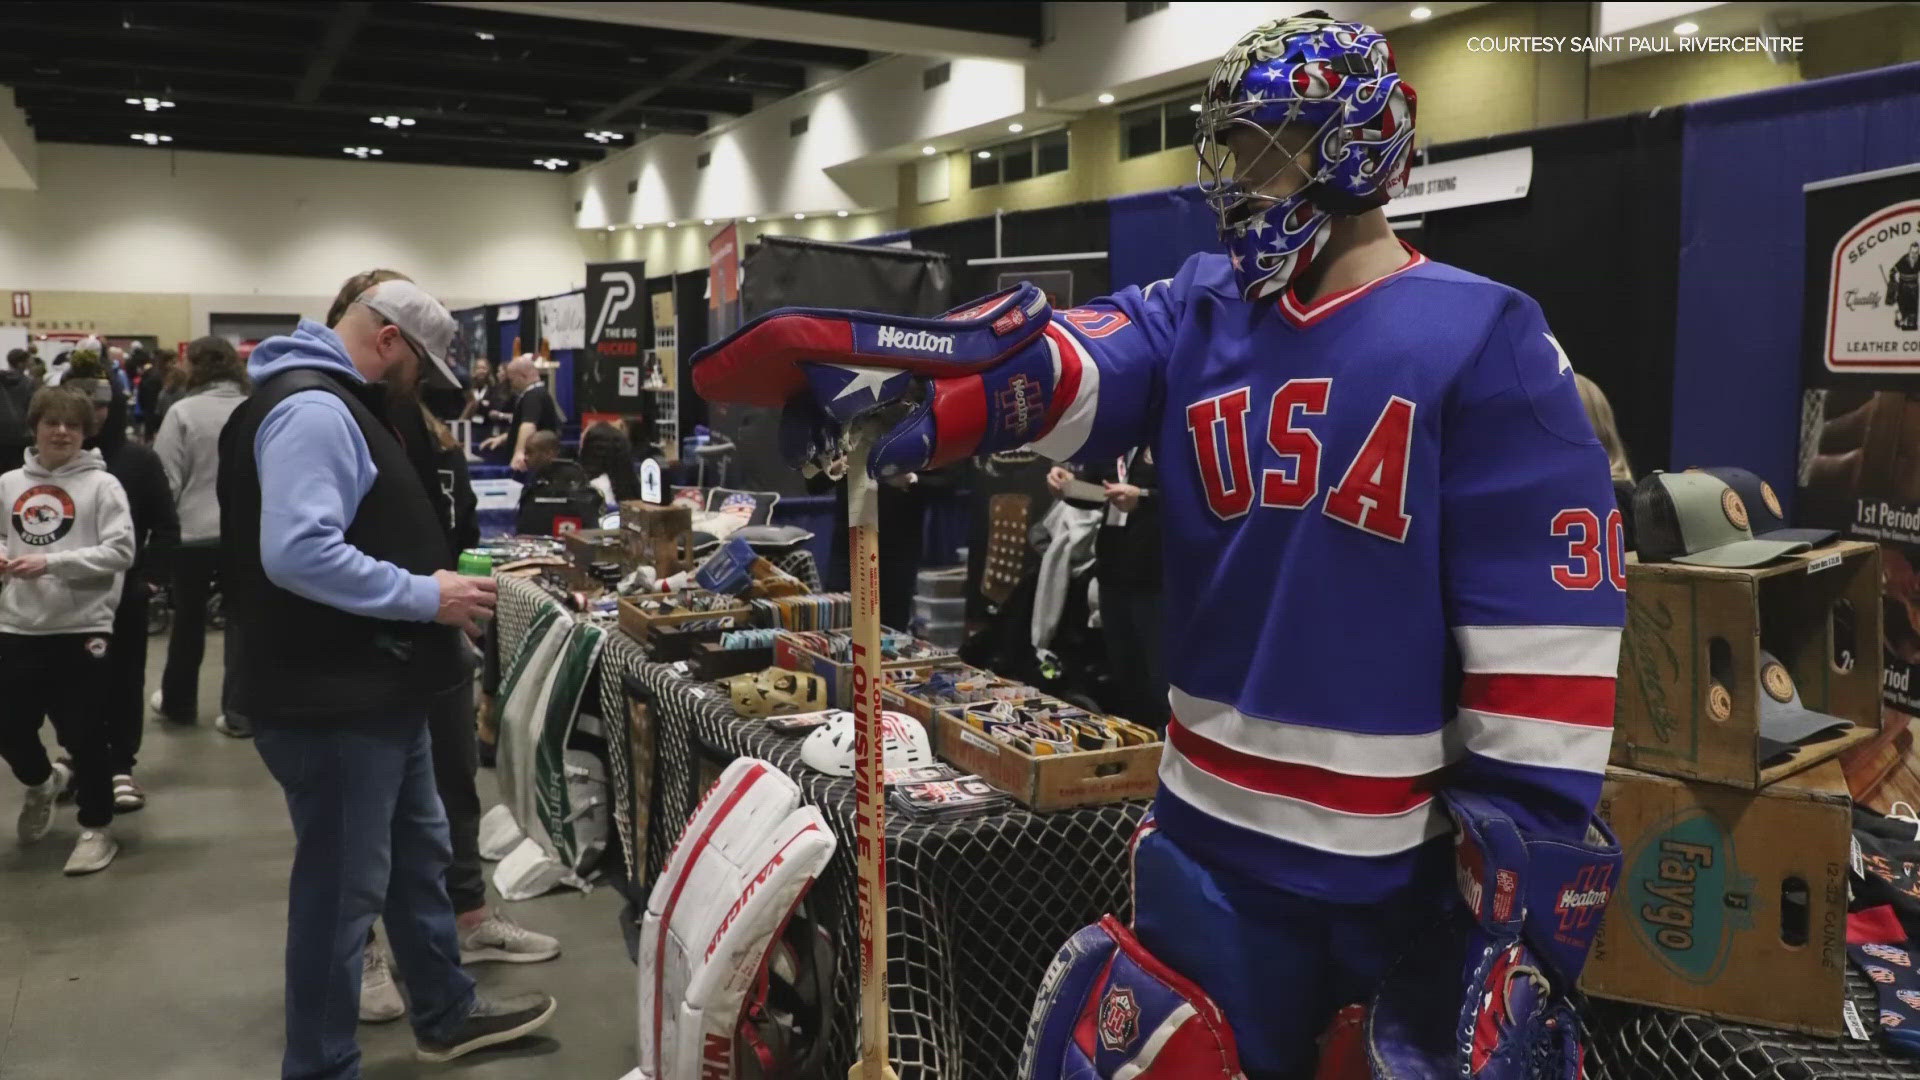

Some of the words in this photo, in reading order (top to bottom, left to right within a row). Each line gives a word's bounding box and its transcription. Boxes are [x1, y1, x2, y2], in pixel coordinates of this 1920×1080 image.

[1427, 176, 1457, 194] STRING
[1848, 221, 1912, 265] SECOND
[605, 328, 620, 339] THE
[622, 327, 637, 339] BIG
[878, 325, 953, 355] Heaton
[1847, 341, 1898, 353] LEATHER
[1012, 377, 1029, 434] Heaton
[1186, 378, 1417, 544] USA
[1858, 499, 1876, 524] 1st
[1879, 502, 1920, 531] Period
[1550, 507, 1627, 593] 30
[1883, 664, 1910, 692] riod
[852, 642, 871, 861] LOUISVILLE
[872, 677, 884, 795] LOUISVILLE
[858, 880, 873, 942] TPS
[1560, 889, 1607, 909] Heaton
[1641, 839, 1714, 951] Faygo
